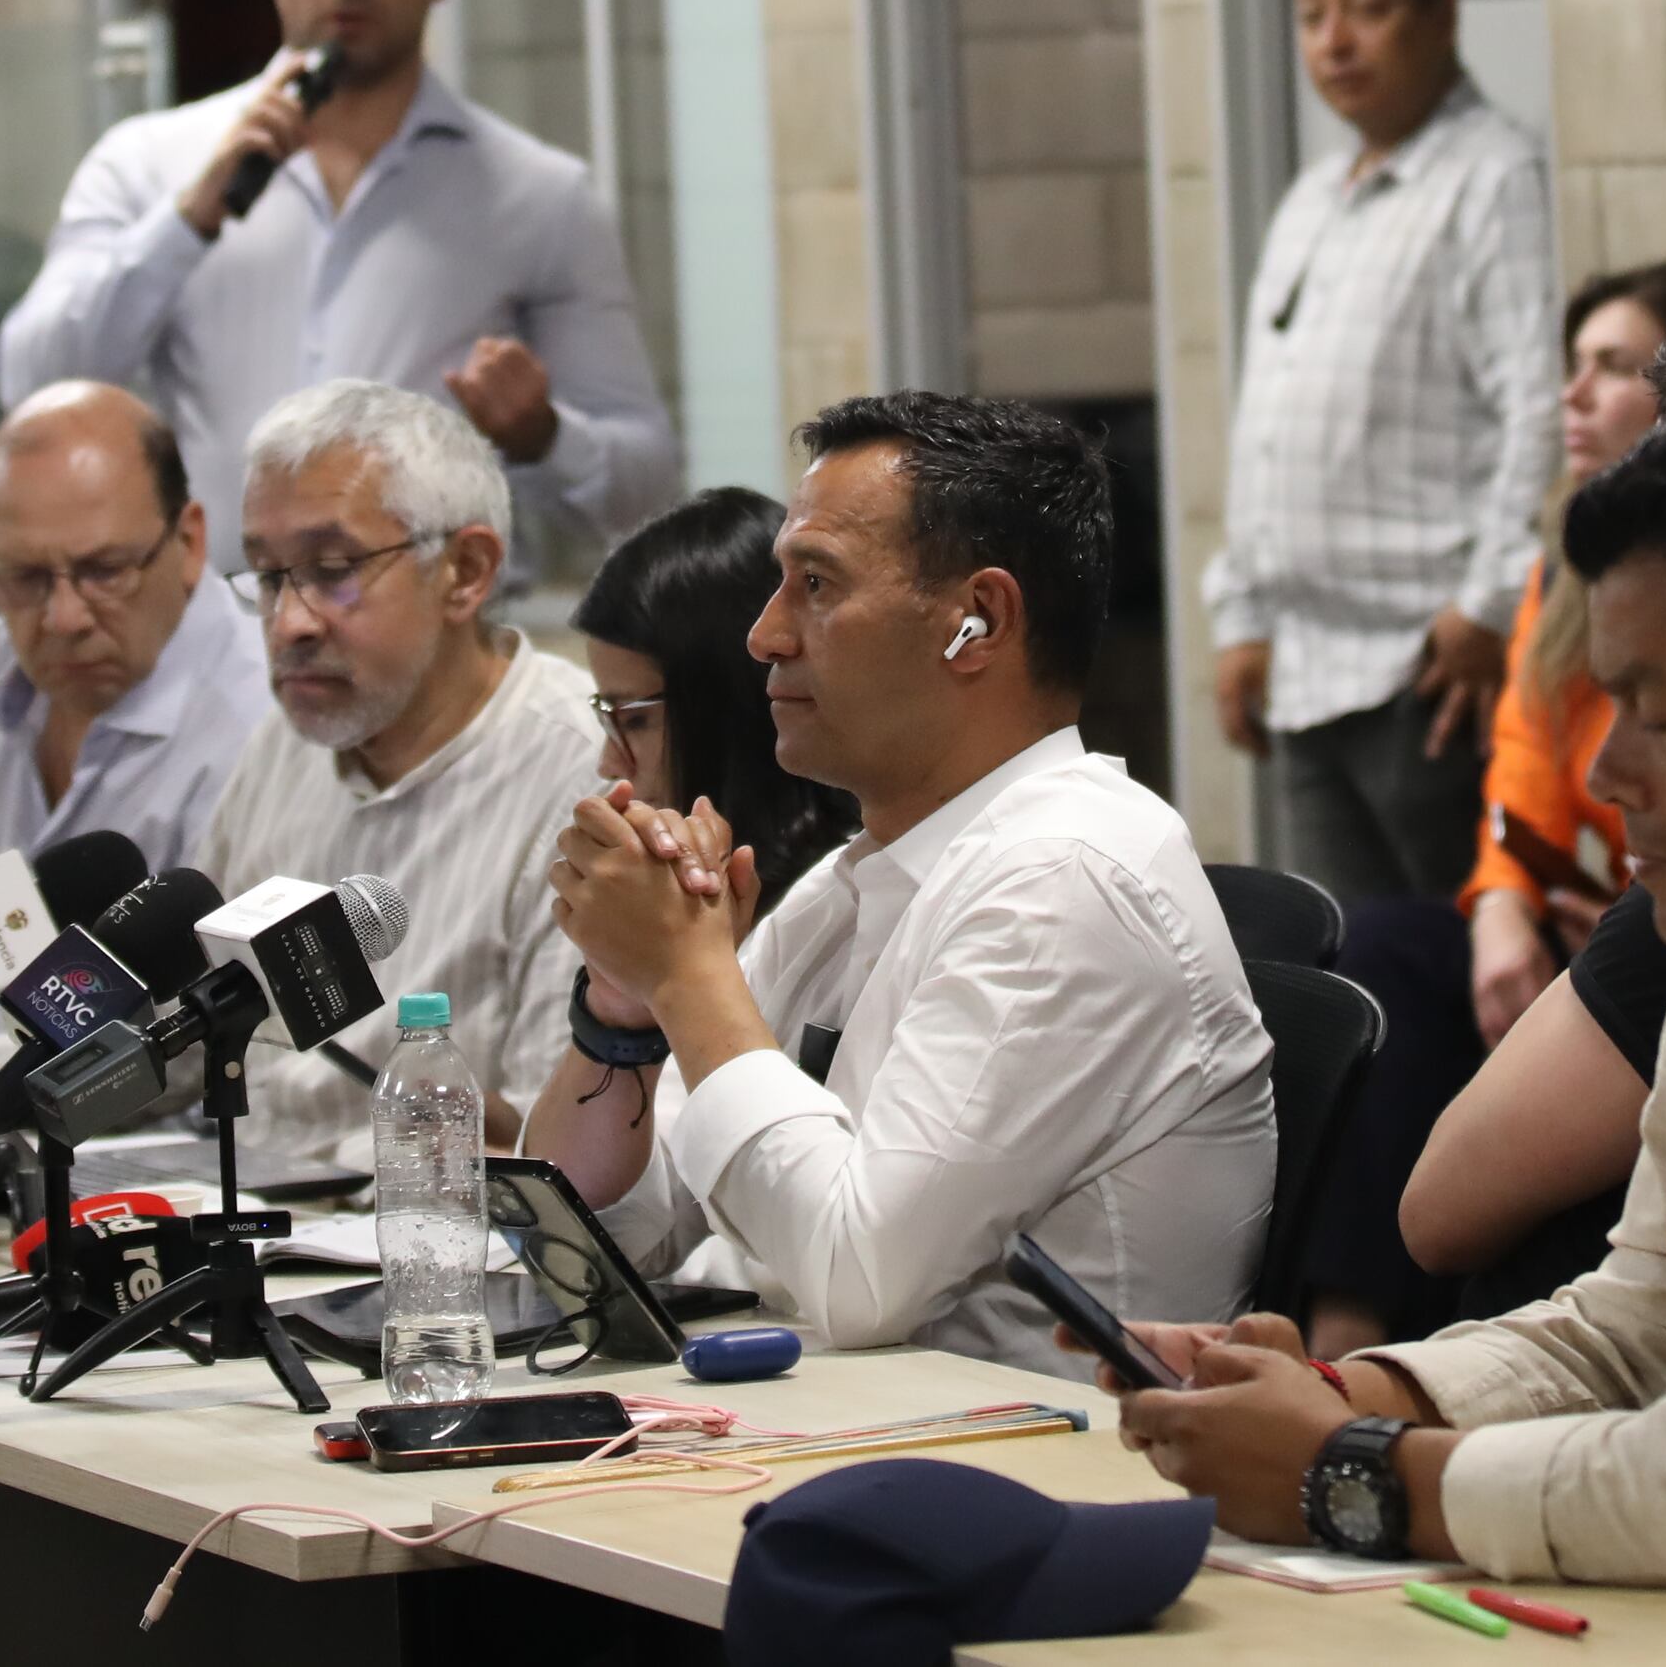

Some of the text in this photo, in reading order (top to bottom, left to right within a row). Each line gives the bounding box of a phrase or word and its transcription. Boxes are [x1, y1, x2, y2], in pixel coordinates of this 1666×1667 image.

[27, 991, 78, 1039] NOTICIAS
[40, 975, 95, 1026] RTVC
[228, 1222, 257, 1232] BOYA
[123, 1245, 163, 1303] re
